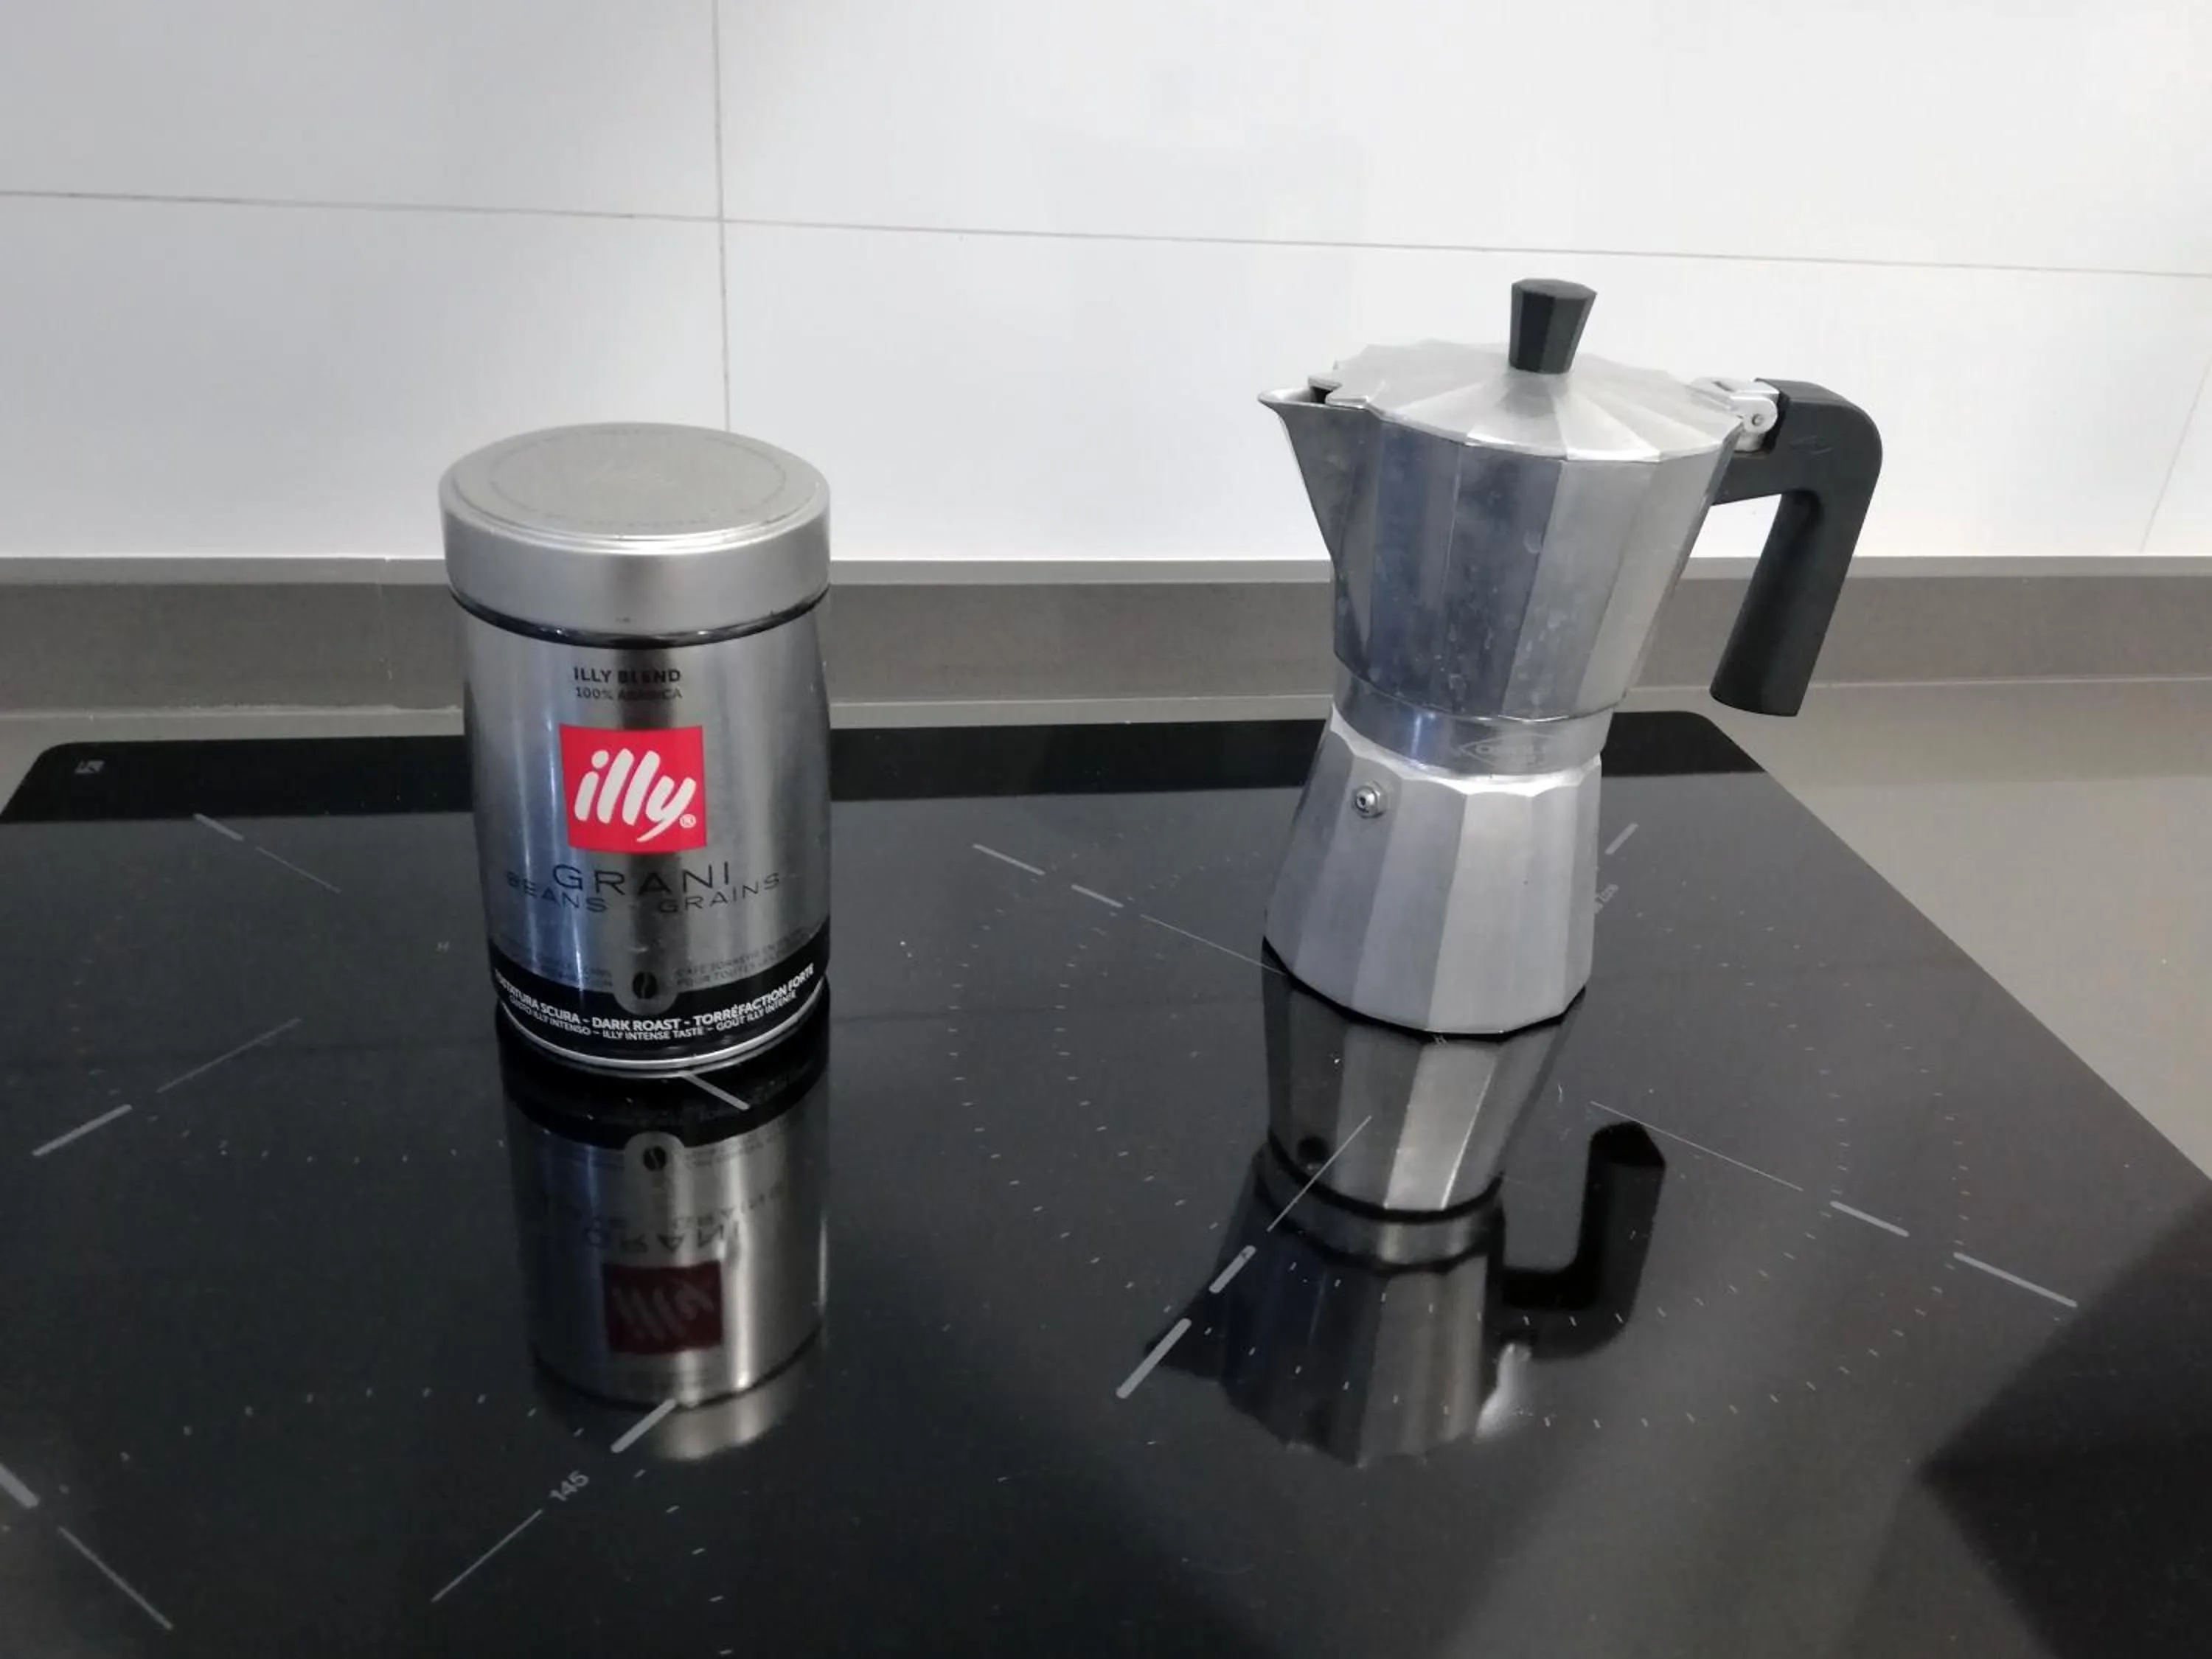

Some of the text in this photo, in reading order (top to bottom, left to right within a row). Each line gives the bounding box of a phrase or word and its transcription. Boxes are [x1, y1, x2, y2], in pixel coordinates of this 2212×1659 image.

[574, 666, 681, 684] ILLY BLEND
[576, 686, 613, 700] 100%
[507, 871, 779, 914] BEANS GRAINS
[553, 861, 729, 896] GRANI
[495, 969, 539, 1009] TATURA
[540, 1002, 581, 1024] SCURA
[592, 1017, 630, 1032] DARK
[633, 1018, 681, 1032] ROAST
[787, 962, 814, 992] FORTE
[549, 1018, 591, 1036] INTENSO
[602, 1030, 623, 1040] ILLY
[625, 1031, 670, 1041] INTENSE
[672, 1026, 704, 1039] TASTE
[747, 1007, 765, 1023] ILLY
[765, 990, 796, 1014] INTENSE
[548, 1470, 589, 1501] 145
